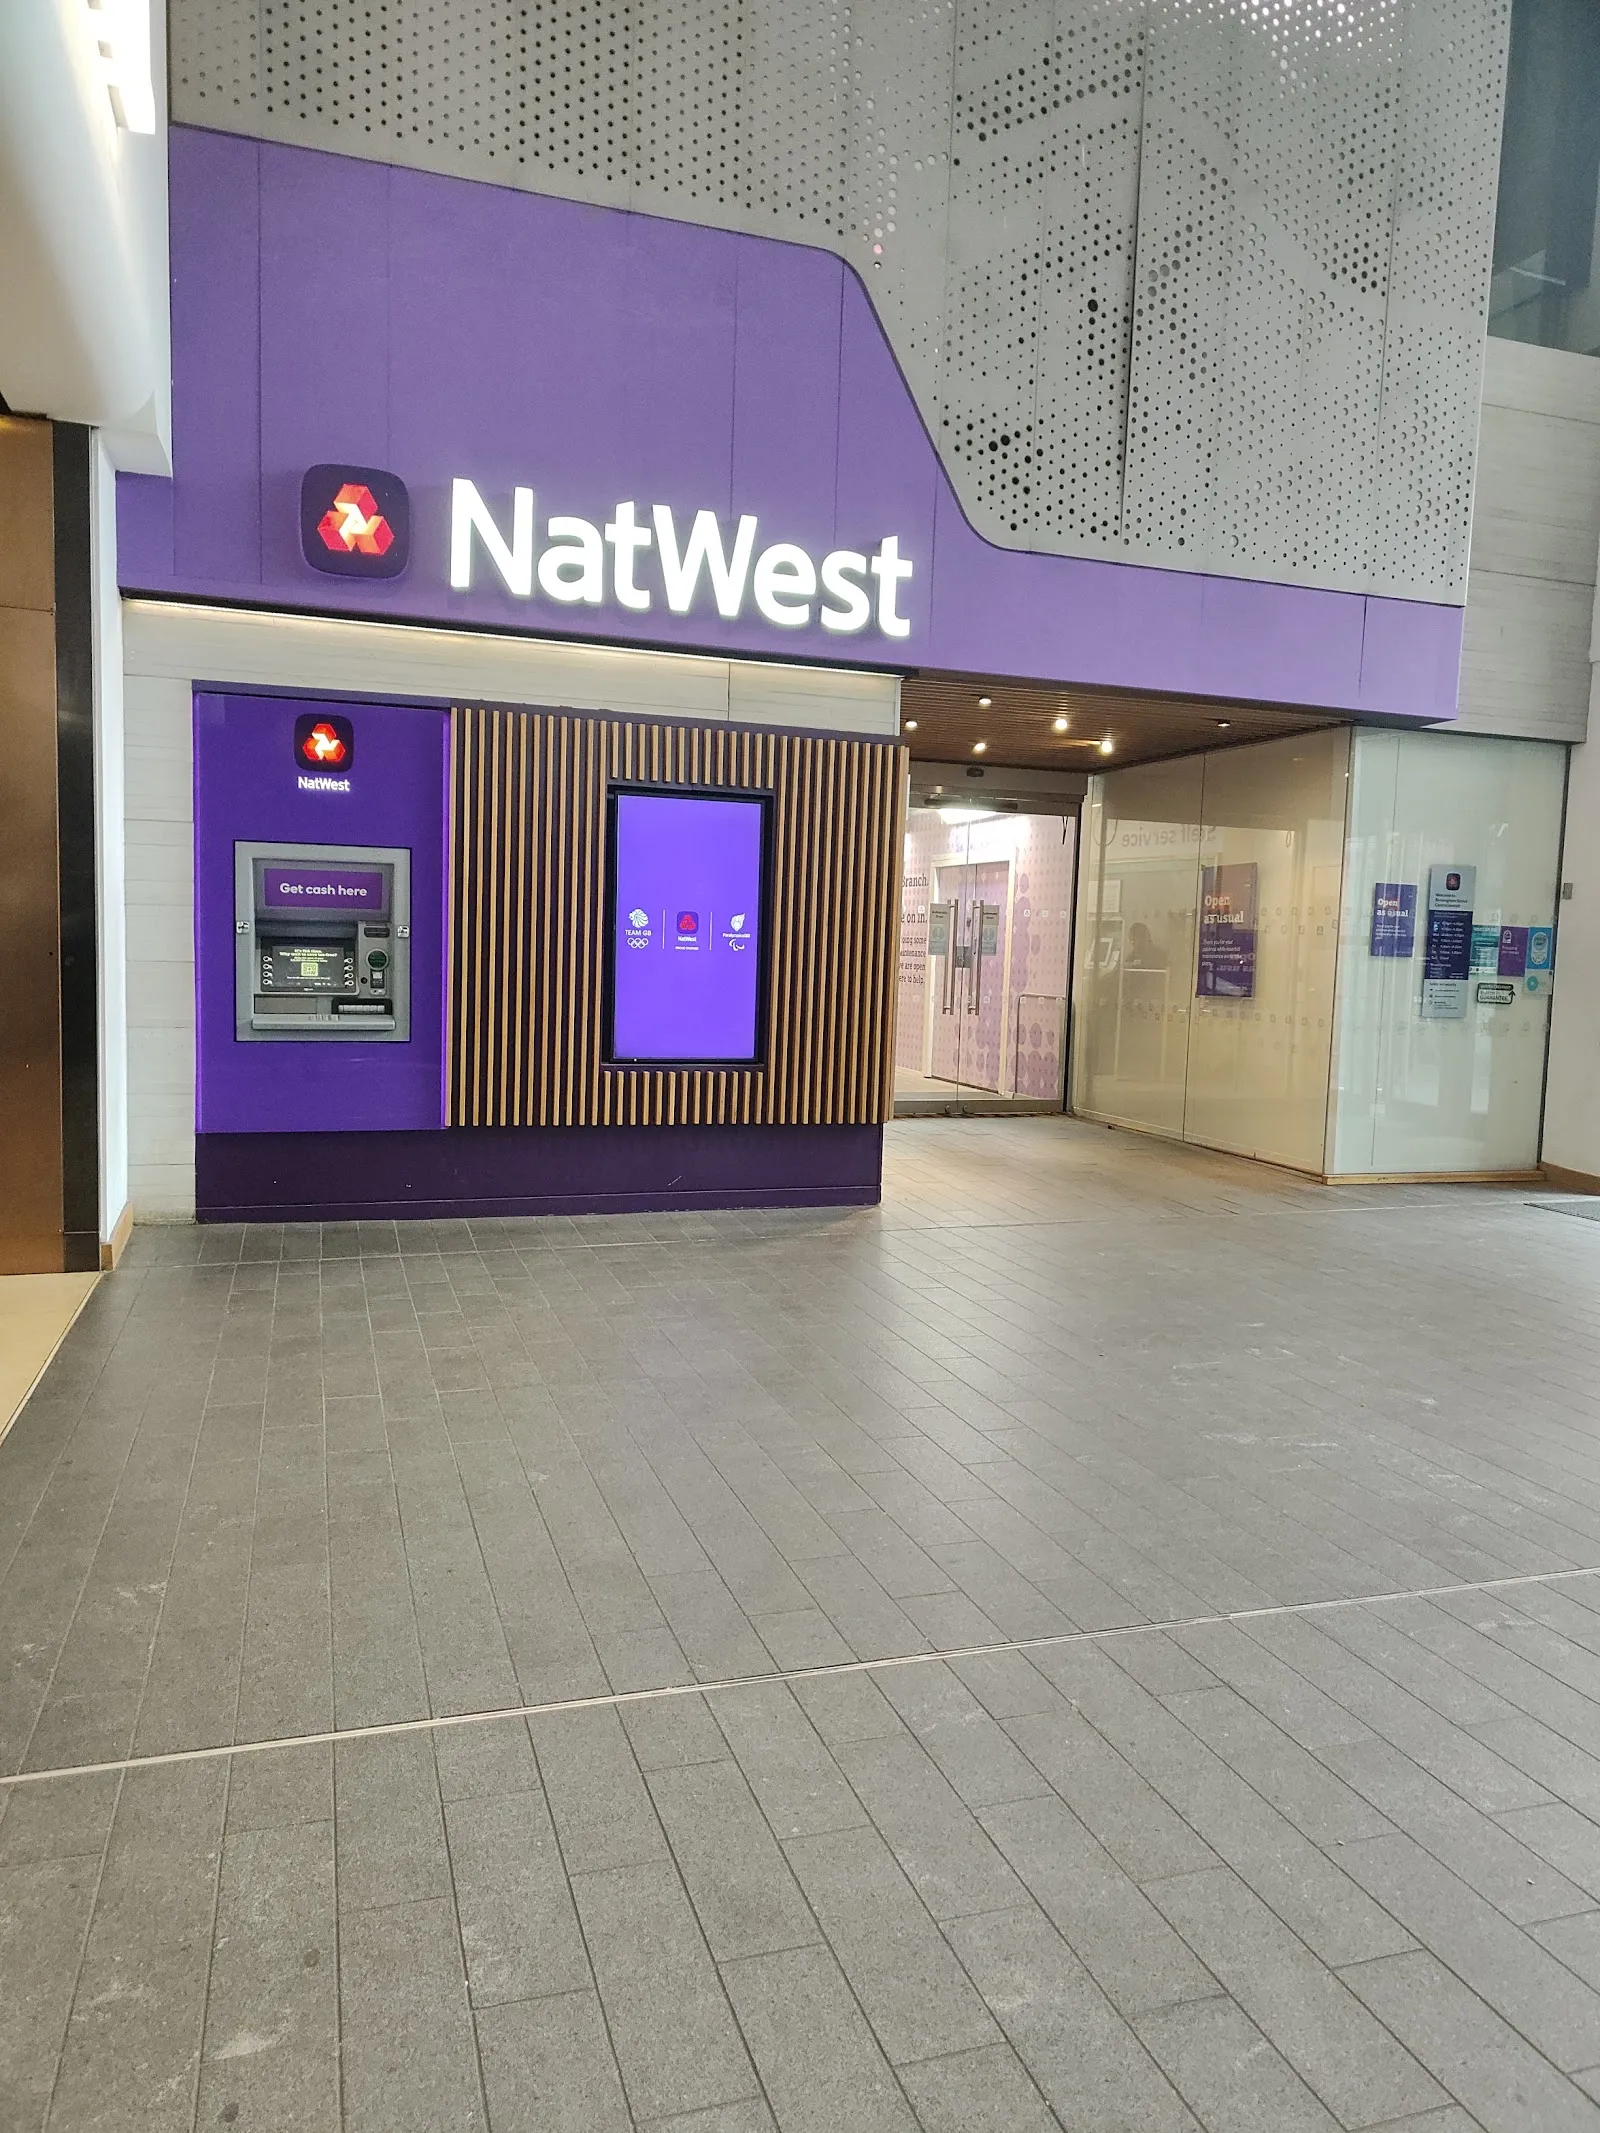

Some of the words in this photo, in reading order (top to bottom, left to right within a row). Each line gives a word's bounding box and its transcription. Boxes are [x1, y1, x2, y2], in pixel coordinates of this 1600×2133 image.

[450, 477, 913, 637] NatWest
[298, 776, 350, 791] NatWest
[279, 883, 304, 895] Get
[305, 884, 335, 896] cash
[337, 885, 368, 897] here
[1204, 895, 1231, 909] Open
[1377, 898, 1398, 907] Open
[906, 913, 916, 923] on
[1203, 915, 1215, 925] as
[1216, 911, 1244, 923] usual
[1387, 909, 1409, 917] usual
[625, 929, 642, 937] TEAM
[643, 929, 652, 937] GB
